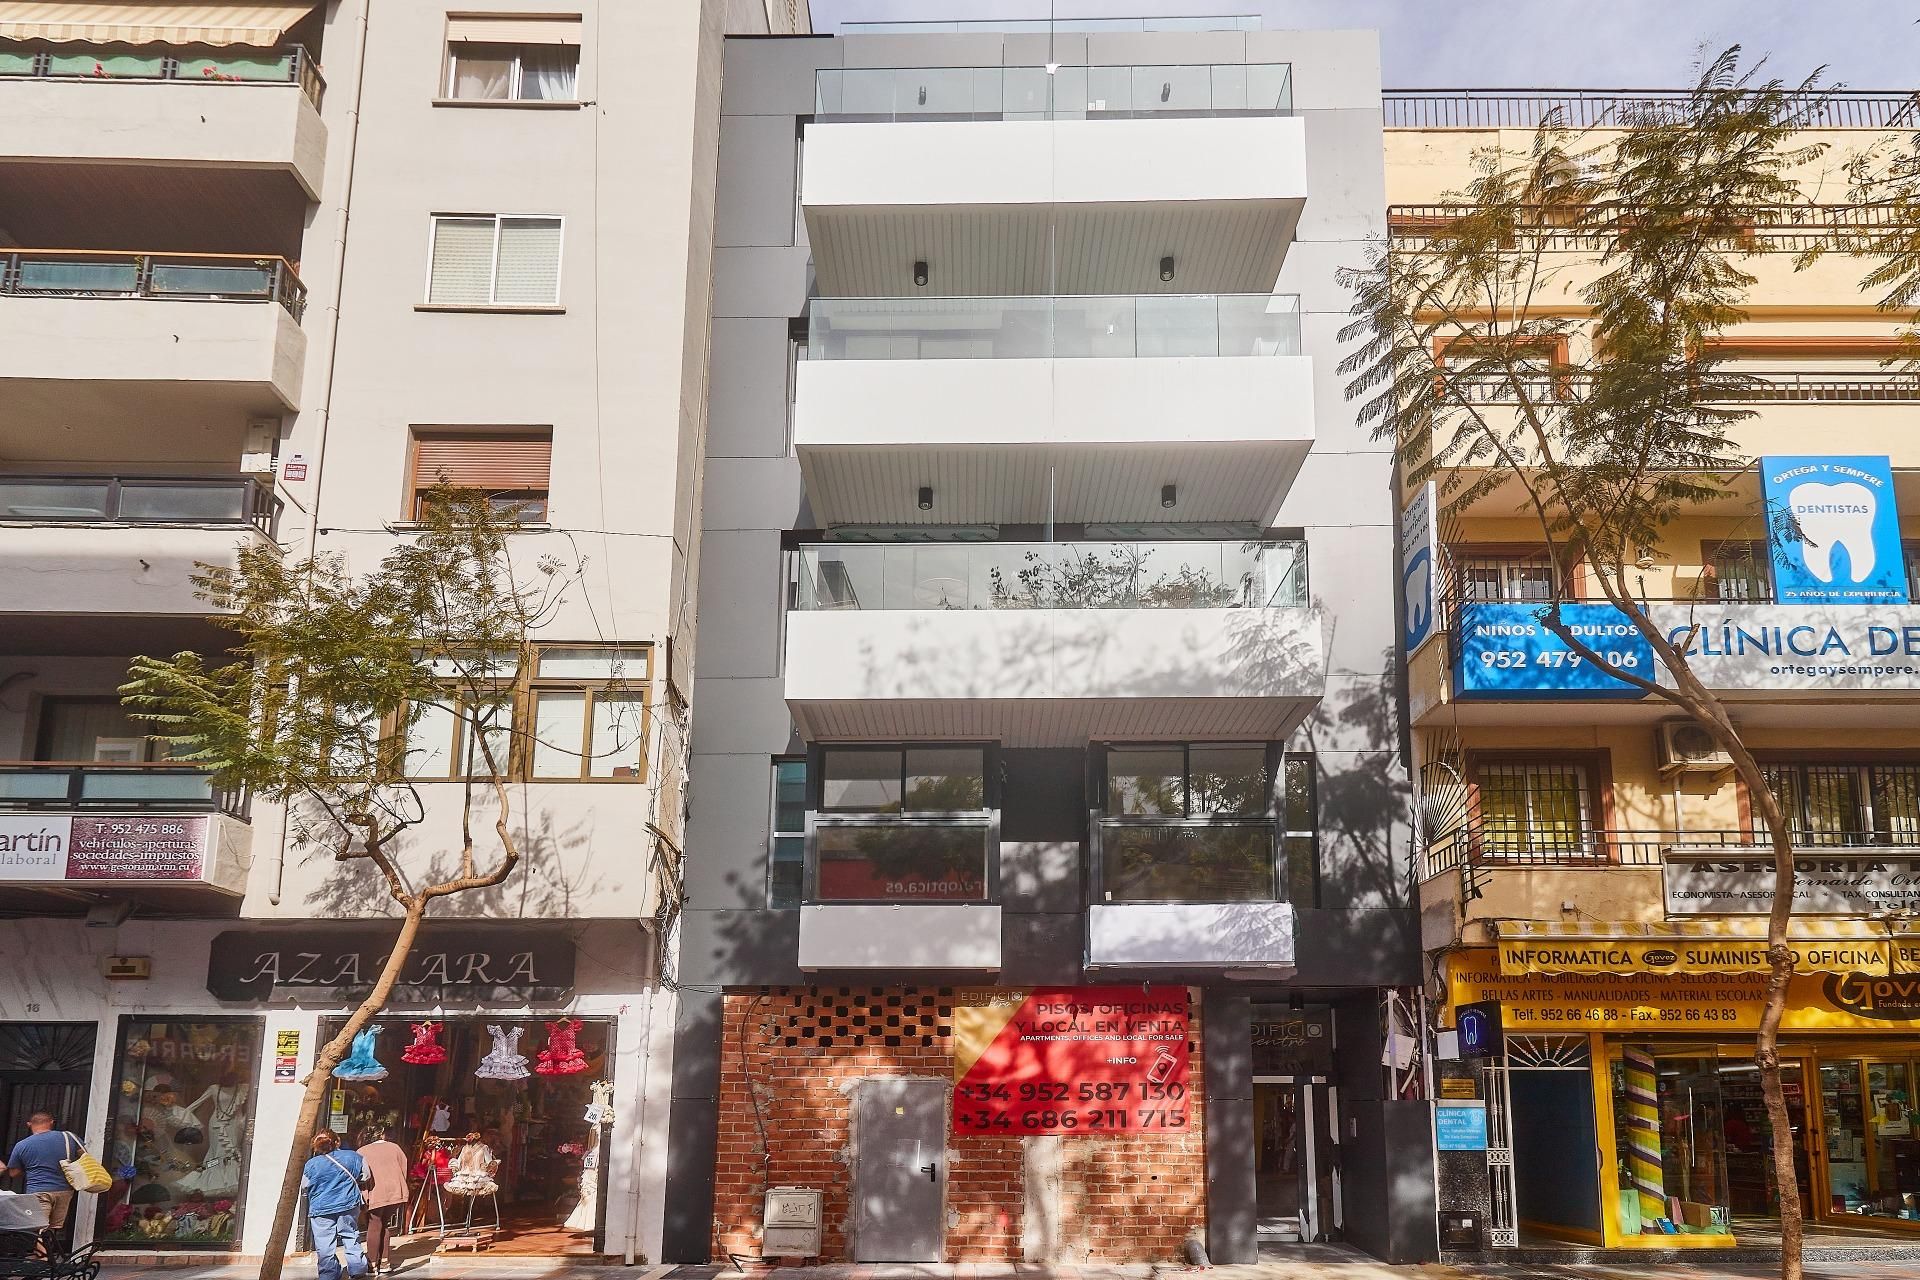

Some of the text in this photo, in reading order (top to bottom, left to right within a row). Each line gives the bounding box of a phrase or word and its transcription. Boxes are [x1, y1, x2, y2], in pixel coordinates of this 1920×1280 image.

[1773, 465, 1818, 484] ORTEGA
[1833, 466, 1884, 488] SEMPERE
[1797, 505, 1869, 514] DENTISTAS
[1476, 622, 1536, 636] NIÑOS
[1570, 625, 1639, 636] DULTOS
[1667, 618, 1851, 657] CLÍNICA
[1481, 651, 1527, 668] 952
[1536, 651, 1582, 668] 479
[111, 823, 132, 834] 952
[135, 823, 157, 834] 475
[161, 823, 183, 834] 886
[1, 853, 57, 865] laboral
[1841, 890, 1861, 898] TAX
[1506, 950, 1633, 965] INFORMATICA
[1686, 950, 1884, 965] SUMINISTO OFICINA
[1456, 971, 1531, 984] INFORMATICA
[1541, 974, 1605, 984] MOBILIARIO
[1608, 973, 1621, 983] DE
[1625, 974, 1671, 984] OFICINA
[1680, 973, 1719, 984] SELLOS
[1721, 974, 1735, 983] DE
[1737, 973, 1771, 984] CAUC
[1482, 989, 1519, 1000] BELLAS
[1522, 989, 1553, 1000] ARTES
[1564, 989, 1650, 1001] MANUALIDADES
[1660, 989, 1712, 1001] MATERIAL
[1716, 989, 1763, 1001] ESCOLAR
[1835, 972, 1920, 1010] Gov
[1036, 1003, 1184, 1016] PISOS, OFICINAS
[1878, 1000, 1912, 1008] Fundada
[1512, 1008, 1537, 1021] Telf.
[1541, 1009, 1563, 1021] 952
[1566, 1009, 1581, 1021] 66
[1585, 1009, 1599, 1021] 46
[1603, 1009, 1618, 1021] 88
[1630, 1009, 1656, 1021] Fax.
[1659, 1009, 1682, 1021] 952
[1685, 1009, 1700, 1021] 66
[1703, 1009, 1718, 1021] 43
[1722, 1009, 1736, 1021] 83
[1015, 1020, 1184, 1033] Y LOCAL EN VENTA
[1250, 1023, 1322, 1037] DIFICIO
[1252, 1035, 1310, 1047] entro
[1106, 1056, 1137, 1065] +INFO
[960, 1082, 1185, 1101] +34 952 587 130
[960, 1109, 1186, 1129] +34 686 211 715
